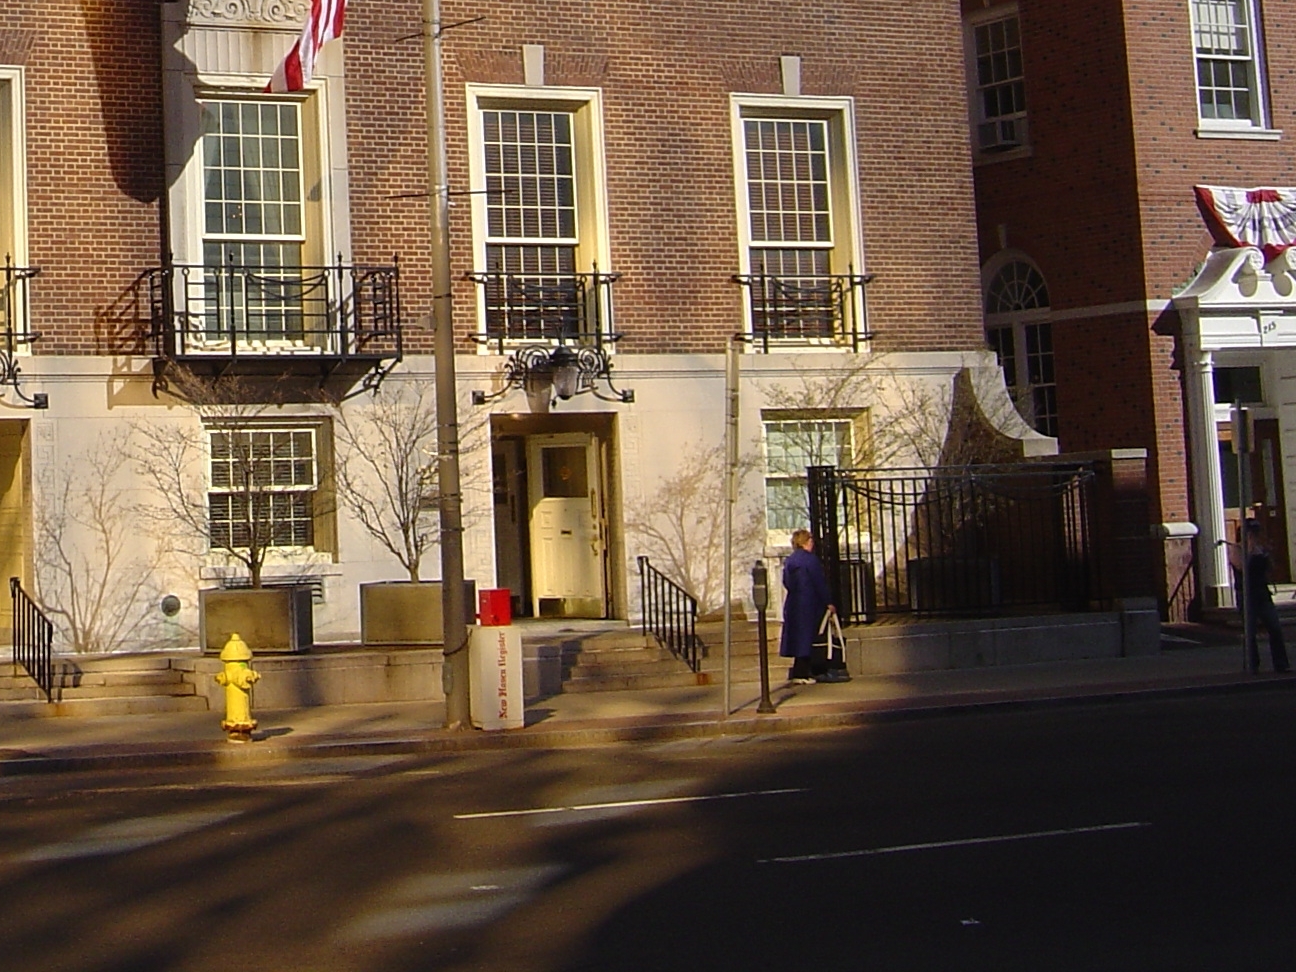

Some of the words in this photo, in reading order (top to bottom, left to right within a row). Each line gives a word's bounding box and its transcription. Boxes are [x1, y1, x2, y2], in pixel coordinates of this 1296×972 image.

[498, 631, 507, 666] Register
[498, 669, 507, 697] Haven
[499, 699, 507, 719] New
